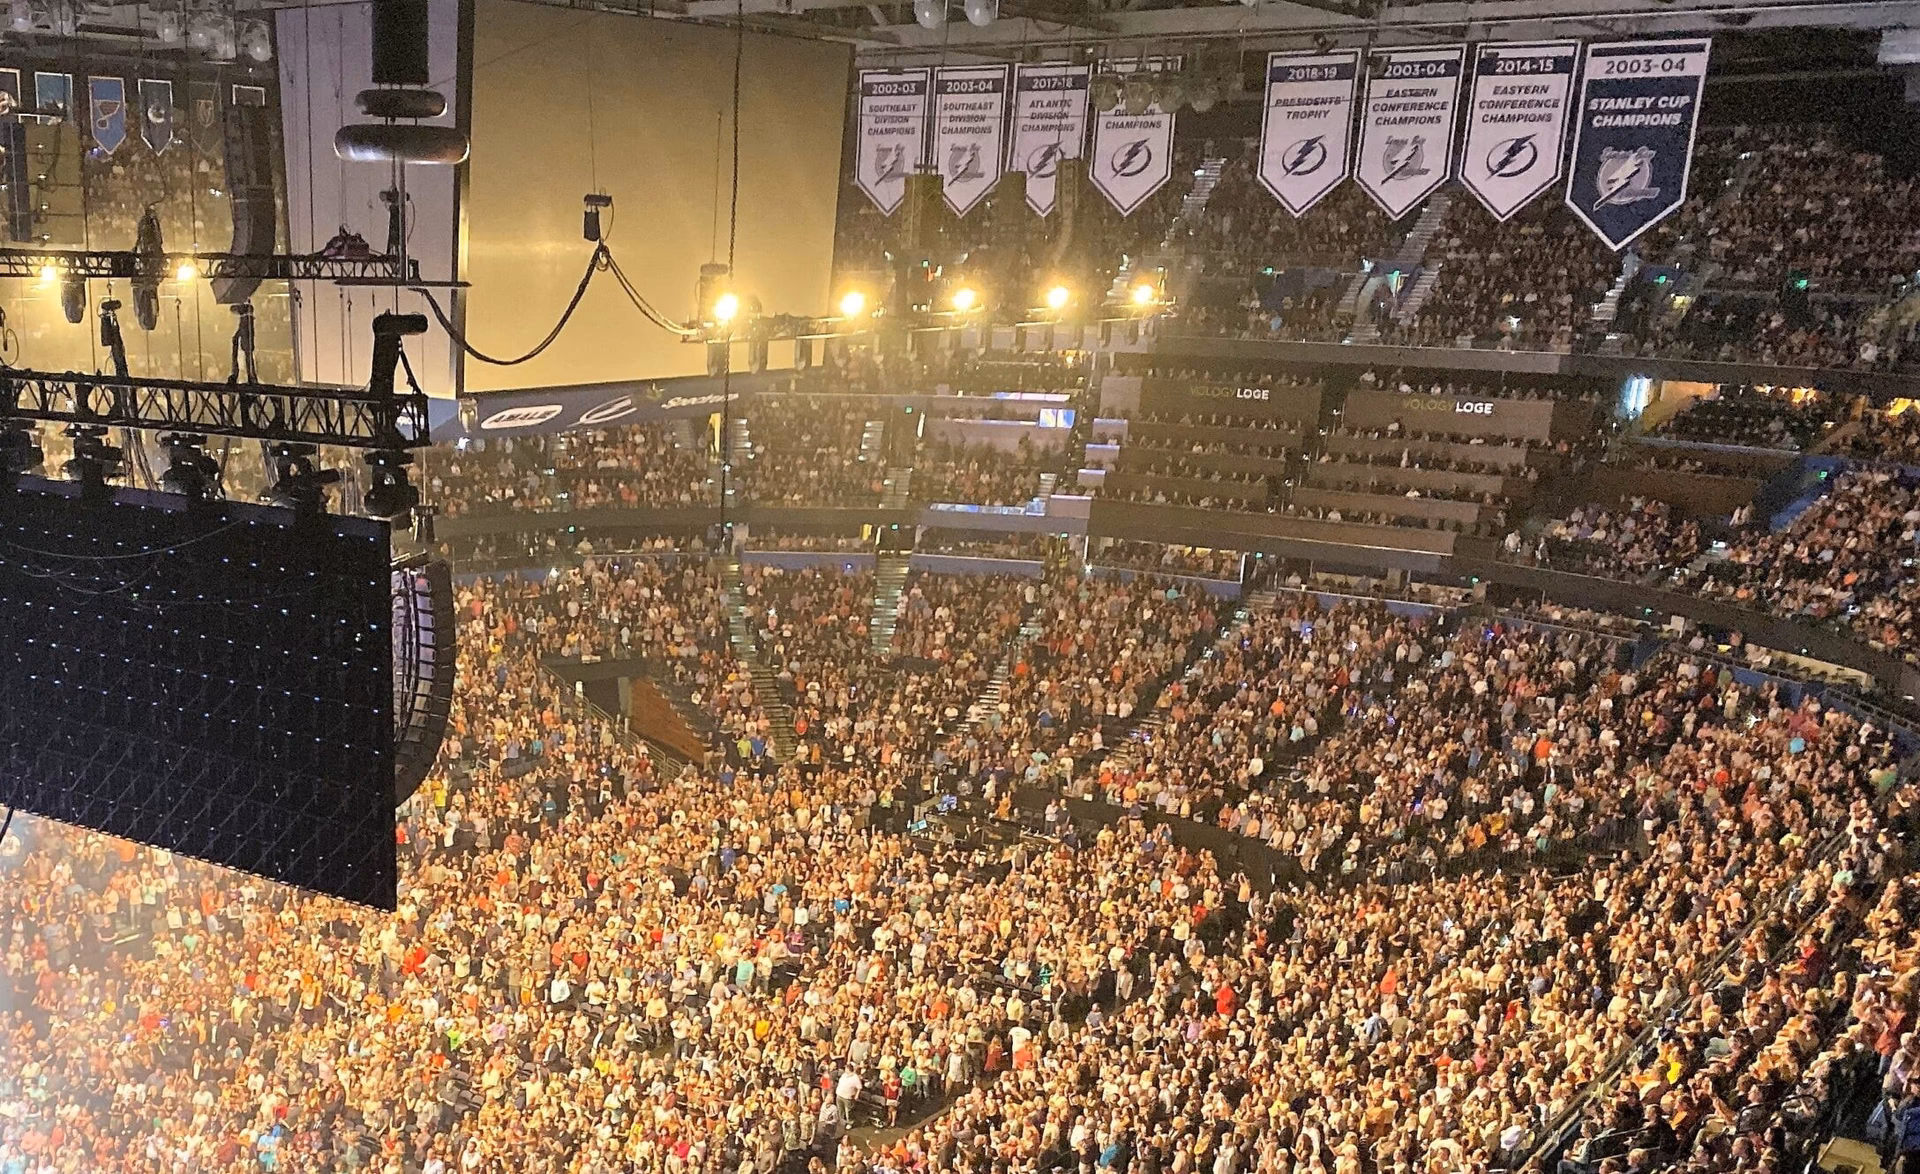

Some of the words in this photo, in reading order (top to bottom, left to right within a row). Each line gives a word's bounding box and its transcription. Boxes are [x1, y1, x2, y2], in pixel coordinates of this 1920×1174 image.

[1384, 65, 1446, 77] 2003-04
[1495, 58, 1554, 73] 2014-15
[1605, 57, 1686, 75] 2003-04
[1288, 67, 1338, 80] 2018-19
[872, 82, 916, 94] 2002-03
[946, 80, 993, 92] 2003-04
[1032, 77, 1073, 89] 2017-18
[1386, 88, 1438, 98] EASTERN
[1493, 85, 1549, 95] EASTERN
[943, 102, 994, 111] SOUTHEAST
[1029, 99, 1072, 108] ATLANTIC
[1372, 101, 1449, 112] CONFERENCE
[1479, 99, 1559, 110] CONFERENCE
[1589, 96, 1655, 110] STANLEY
[1658, 95, 1690, 108] CUP
[868, 104, 917, 113] SOUTHEAST
[1114, 109, 1155, 117] DION
[874, 115, 909, 124] DIVISION
[949, 114, 986, 123] DIVISION
[1286, 110, 1330, 119] TROPHY
[1481, 112, 1552, 124] CHAMPIONS
[1592, 112, 1682, 128] CHAMPIONS
[1105, 121, 1162, 130] CHAMPIONS
[1375, 115, 1442, 126] CHAMPIONS
[867, 127, 916, 136] CHAMPIONS
[941, 125, 993, 135] CHAMPIONS
[1021, 124, 1075, 133] CHAMPIONS
[1236, 388, 1270, 400] LOGE
[1455, 401, 1494, 414] LOGE
